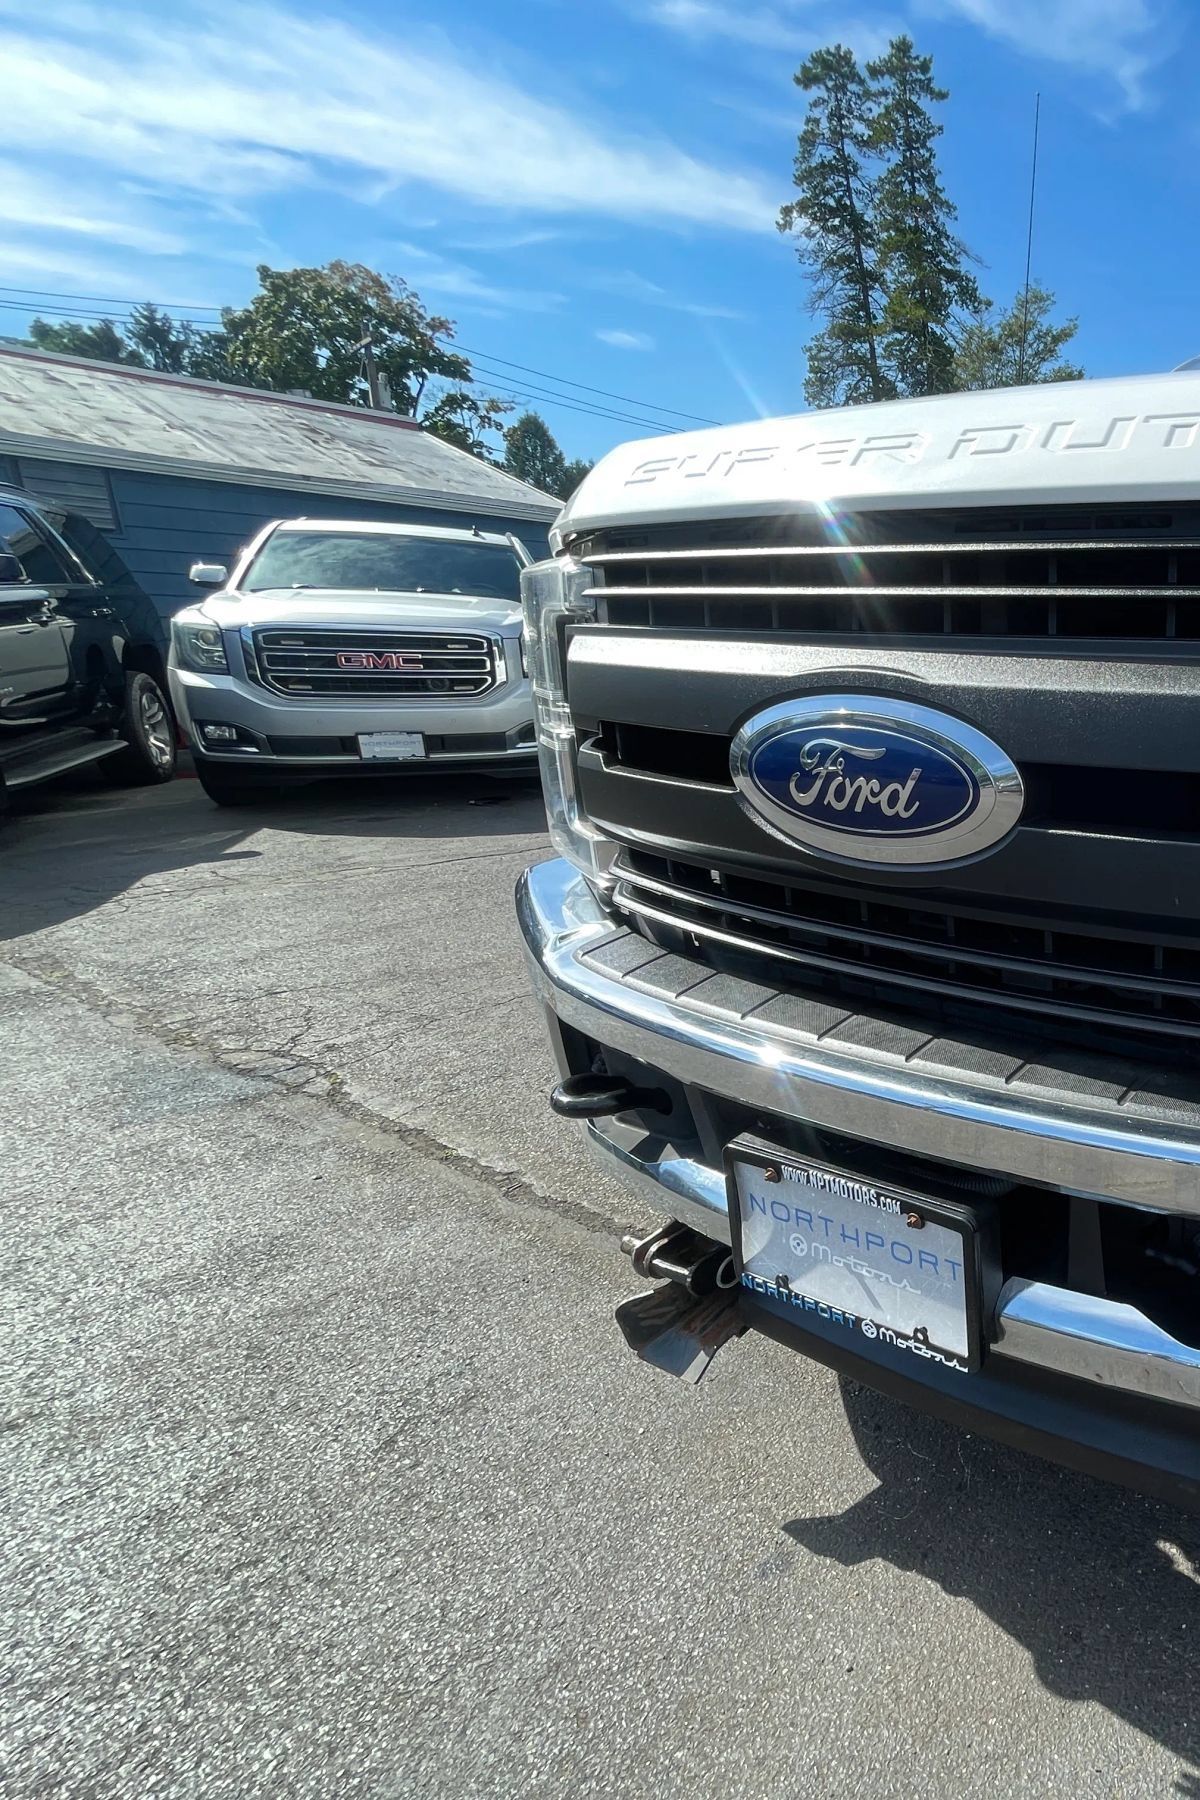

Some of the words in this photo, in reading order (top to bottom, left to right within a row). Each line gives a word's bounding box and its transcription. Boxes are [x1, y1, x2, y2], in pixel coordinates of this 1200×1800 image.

[623, 431, 929, 487] SUPER
[336, 652, 424, 670] GMC
[789, 738, 922, 819] Ford
[749, 1193, 962, 1281] NORTHPORT
[740, 1273, 856, 1329] NORTHPORT
